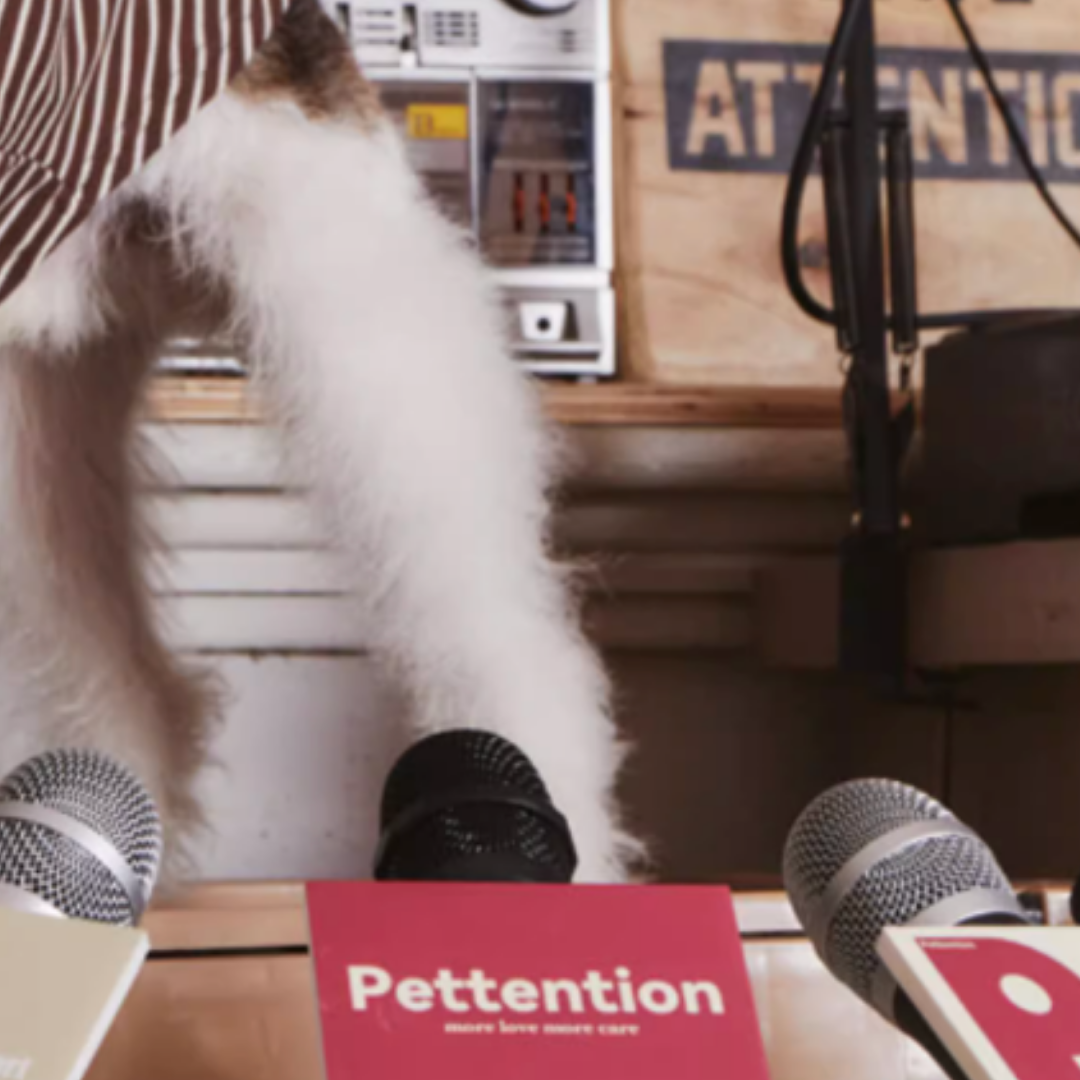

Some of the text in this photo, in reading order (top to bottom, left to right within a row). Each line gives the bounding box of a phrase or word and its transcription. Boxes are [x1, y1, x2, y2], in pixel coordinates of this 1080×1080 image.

[347, 964, 726, 1015] Pettention
[444, 1020, 641, 1036] more love more care
